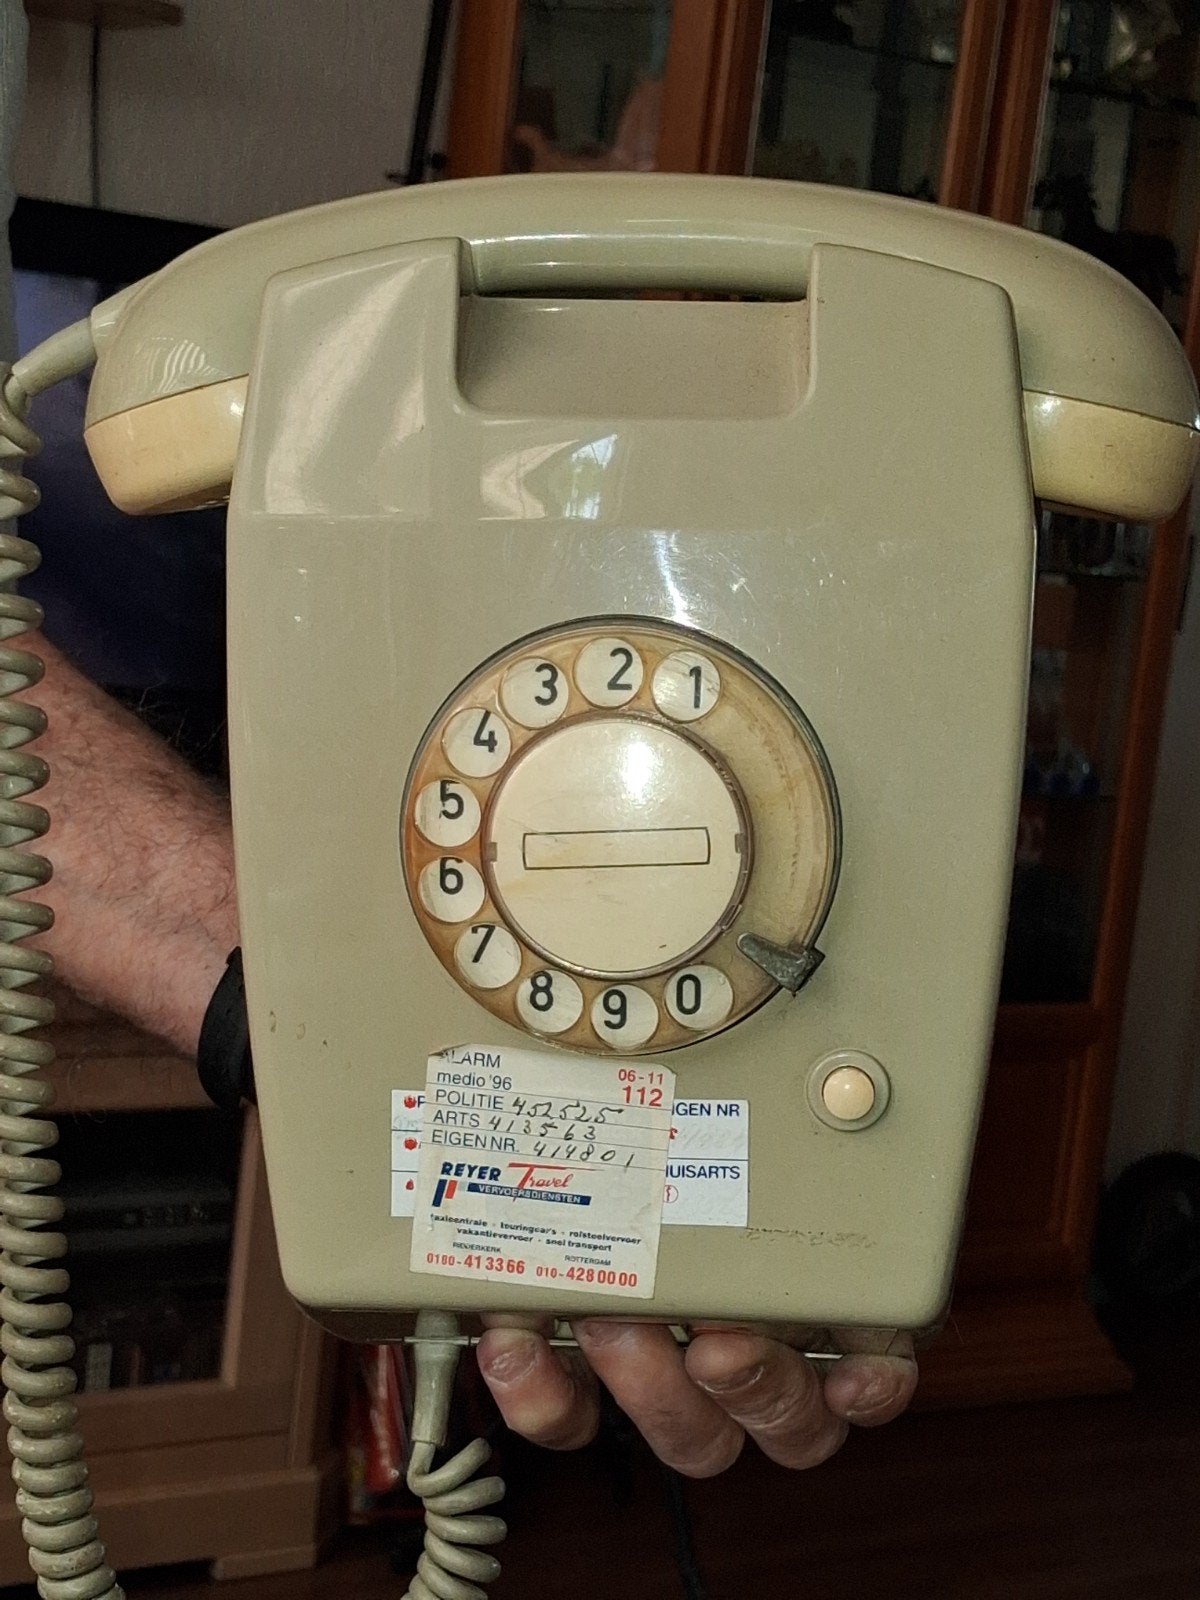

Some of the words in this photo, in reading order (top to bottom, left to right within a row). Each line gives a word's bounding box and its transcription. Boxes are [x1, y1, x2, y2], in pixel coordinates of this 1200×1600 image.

[534, 663, 559, 706] 3
[606, 647, 633, 691] 2
[688, 665, 702, 709] 1
[472, 711, 498, 753] 4
[439, 780, 465, 820] 5
[439, 857, 464, 895] 6
[471, 924, 496, 964] 7
[529, 971, 554, 1012] 8
[602, 989, 628, 1030] 9
[675, 973, 701, 1015] 0
[442, 1050, 501, 1069] LARM
[618, 1068, 664, 1086] 06-11
[435, 1088, 505, 1110] POLITIE
[437, 1071, 486, 1087] medio
[489, 1074, 512, 1091] '96
[622, 1085, 663, 1107] 112
[433, 1109, 480, 1128] ARTS
[671, 1102, 711, 1117] IGEN
[716, 1103, 740, 1117] NR
[431, 1129, 487, 1148] EIGEN
[490, 1135, 520, 1153] NR.
[488, 1115, 597, 1141] 413563
[533, 1140, 635, 1168] 414801
[440, 1161, 502, 1182] REYER
[508, 1162, 600, 1193] Travel
[478, 1184, 581, 1203] VERVOERSDIENSTEN
[430, 1213, 488, 1227] taxicentrale
[457, 1227, 534, 1243] vakantievervoer
[567, 1240, 613, 1252] transport
